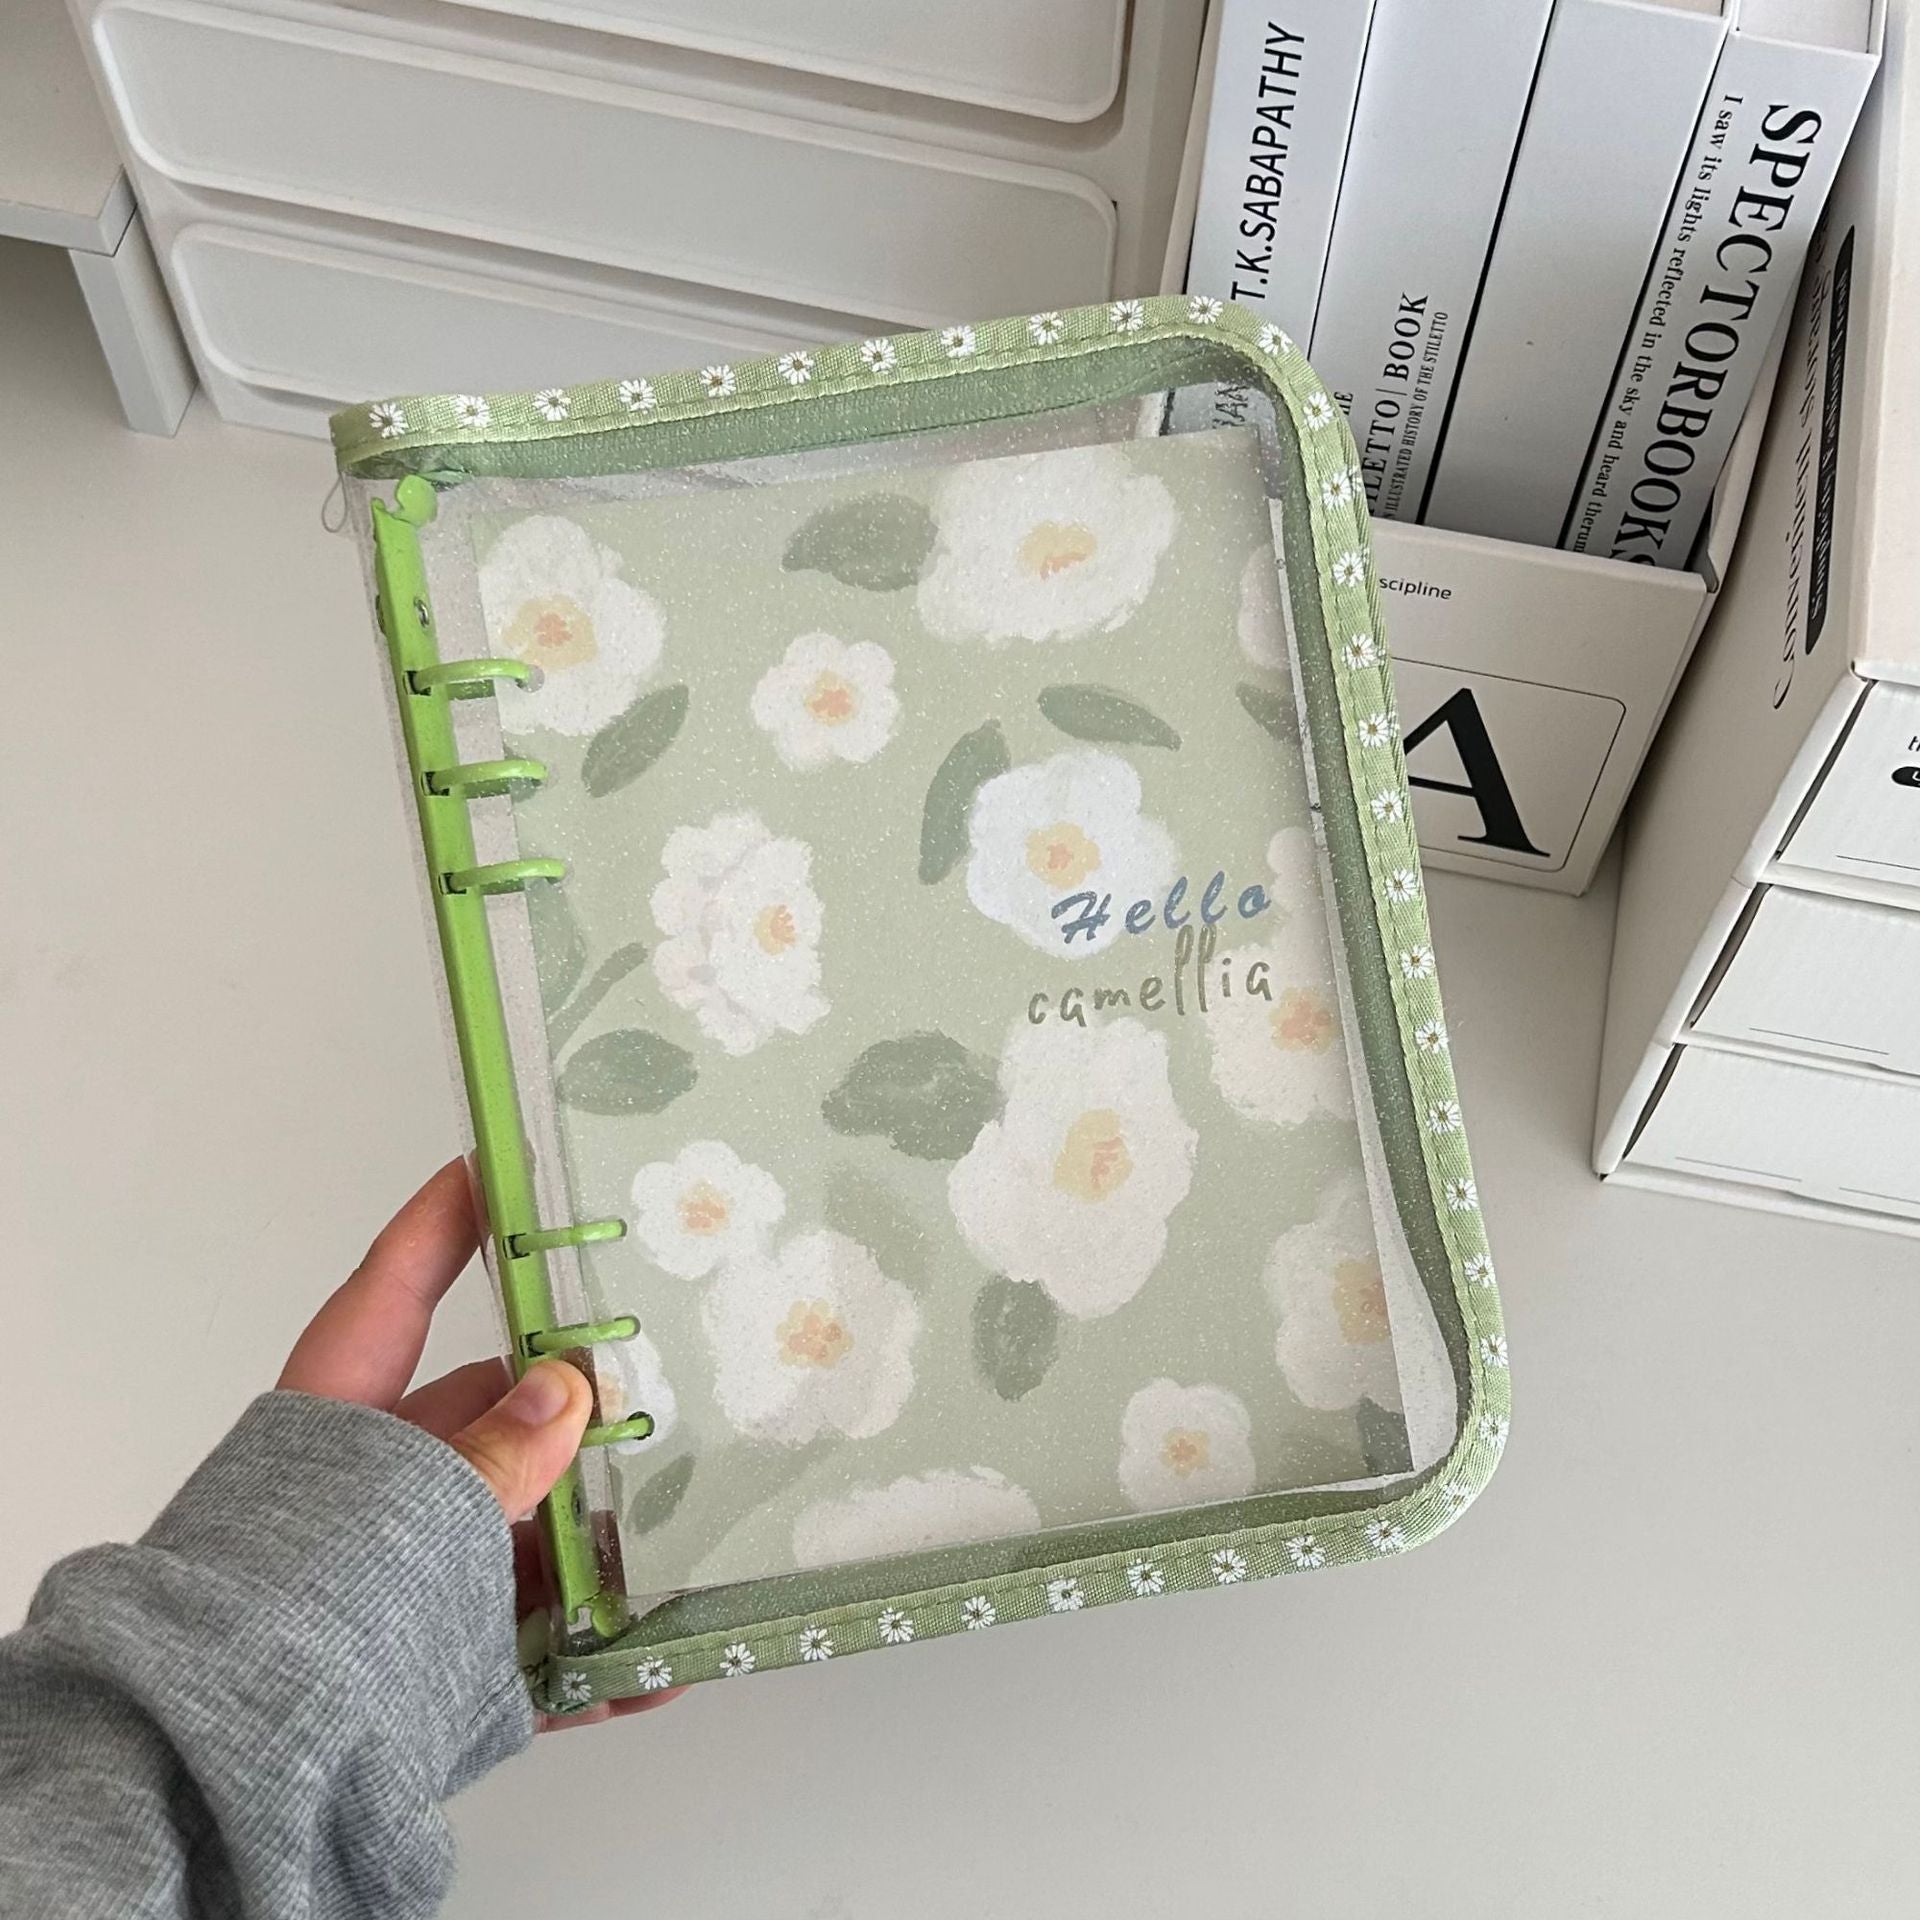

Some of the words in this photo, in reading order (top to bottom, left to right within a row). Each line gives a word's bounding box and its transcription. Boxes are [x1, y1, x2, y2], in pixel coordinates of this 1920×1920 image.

[1724, 94, 1744, 105] I
[1709, 109, 1733, 149] saw
[1230, 21, 1305, 300] T.K.SABAPATHY
[1697, 155, 1722, 181] its
[1677, 186, 1711, 243] lights
[1649, 248, 1686, 327] reflected
[1383, 292, 1428, 381] BOOK
[1423, 311, 1448, 363] STILETTO
[1641, 331, 1662, 349] in
[1417, 364, 1435, 387] THE
[1630, 355, 1653, 383] the
[1414, 388, 1428, 402] OF
[1618, 387, 1641, 416] sky
[1402, 403, 1425, 447] HISTORY
[1607, 420, 1627, 450] and
[1385, 448, 1413, 511] ILLUSTRATED
[1591, 454, 1620, 498] heard
[1051, 870, 1271, 944] Hello
[1028, 924, 1273, 1027] camellia
